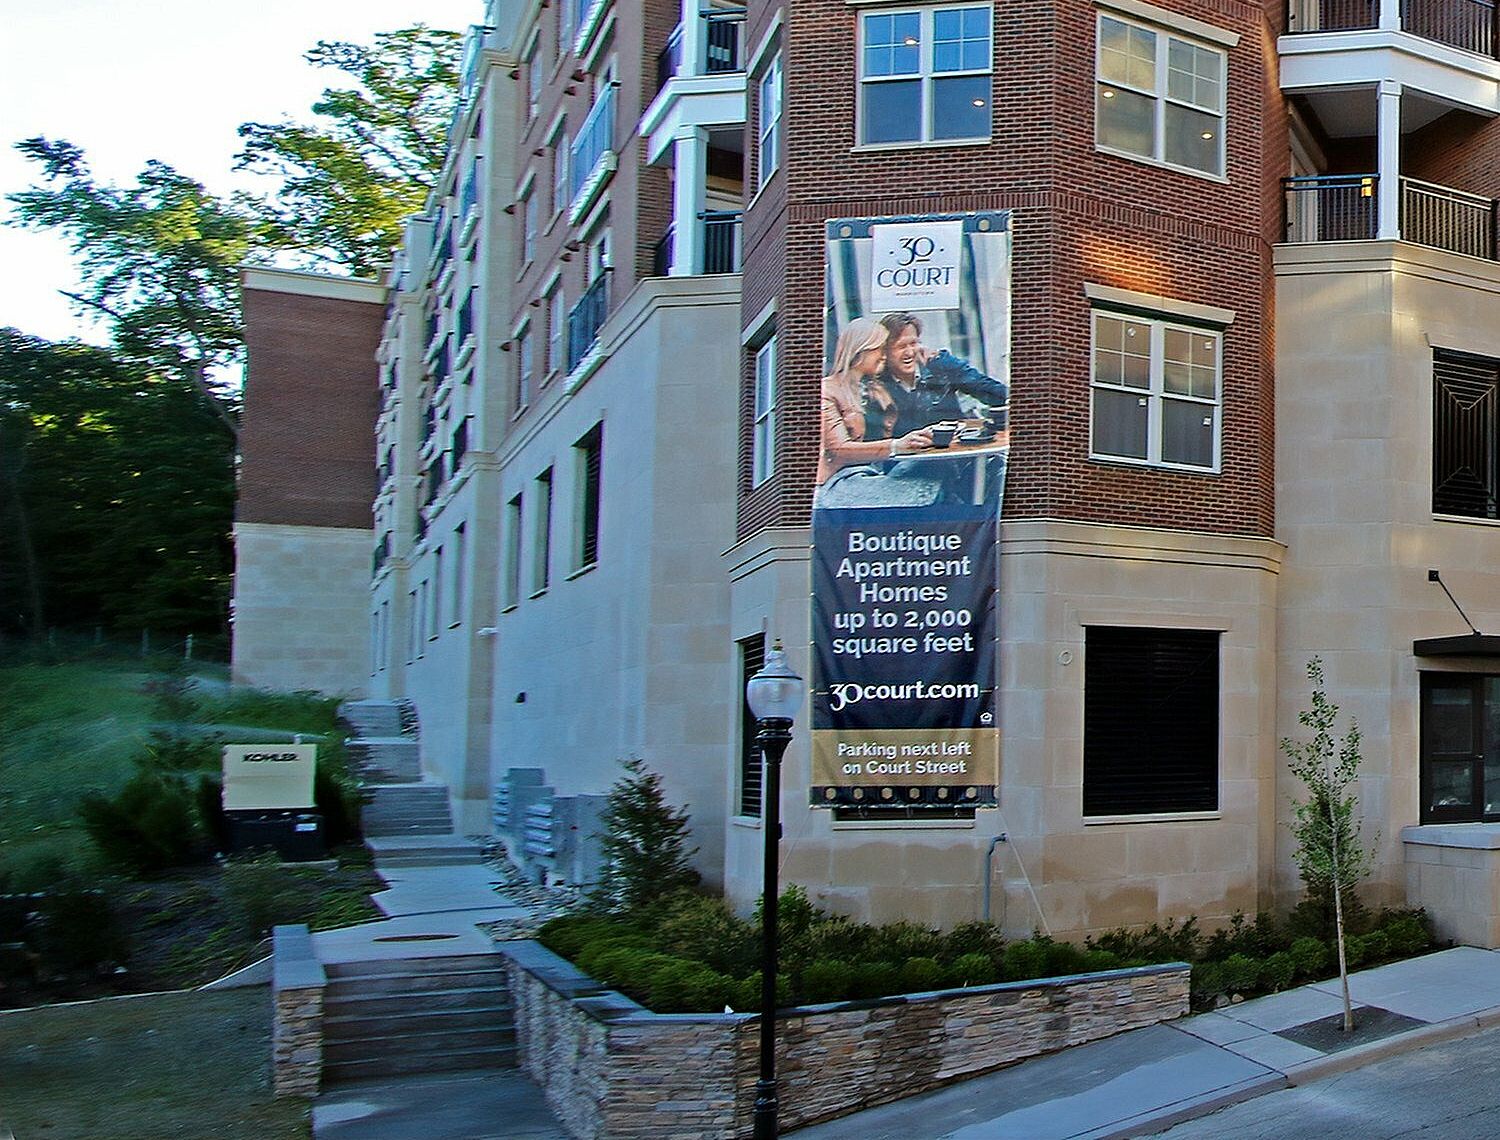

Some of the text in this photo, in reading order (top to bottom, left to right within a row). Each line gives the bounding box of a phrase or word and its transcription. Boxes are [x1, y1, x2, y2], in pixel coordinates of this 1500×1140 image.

[898, 236, 934, 266] 30
[877, 266, 954, 288] COURT
[848, 531, 961, 555] Boutique
[836, 556, 971, 582] Apartment
[860, 582, 948, 603] Homes
[834, 609, 972, 633] up to 2,000
[832, 633, 974, 658] square feet
[829, 681, 979, 712] 30court.com
[838, 740, 972, 760] Parking next left
[842, 760, 966, 775] on Court Street
